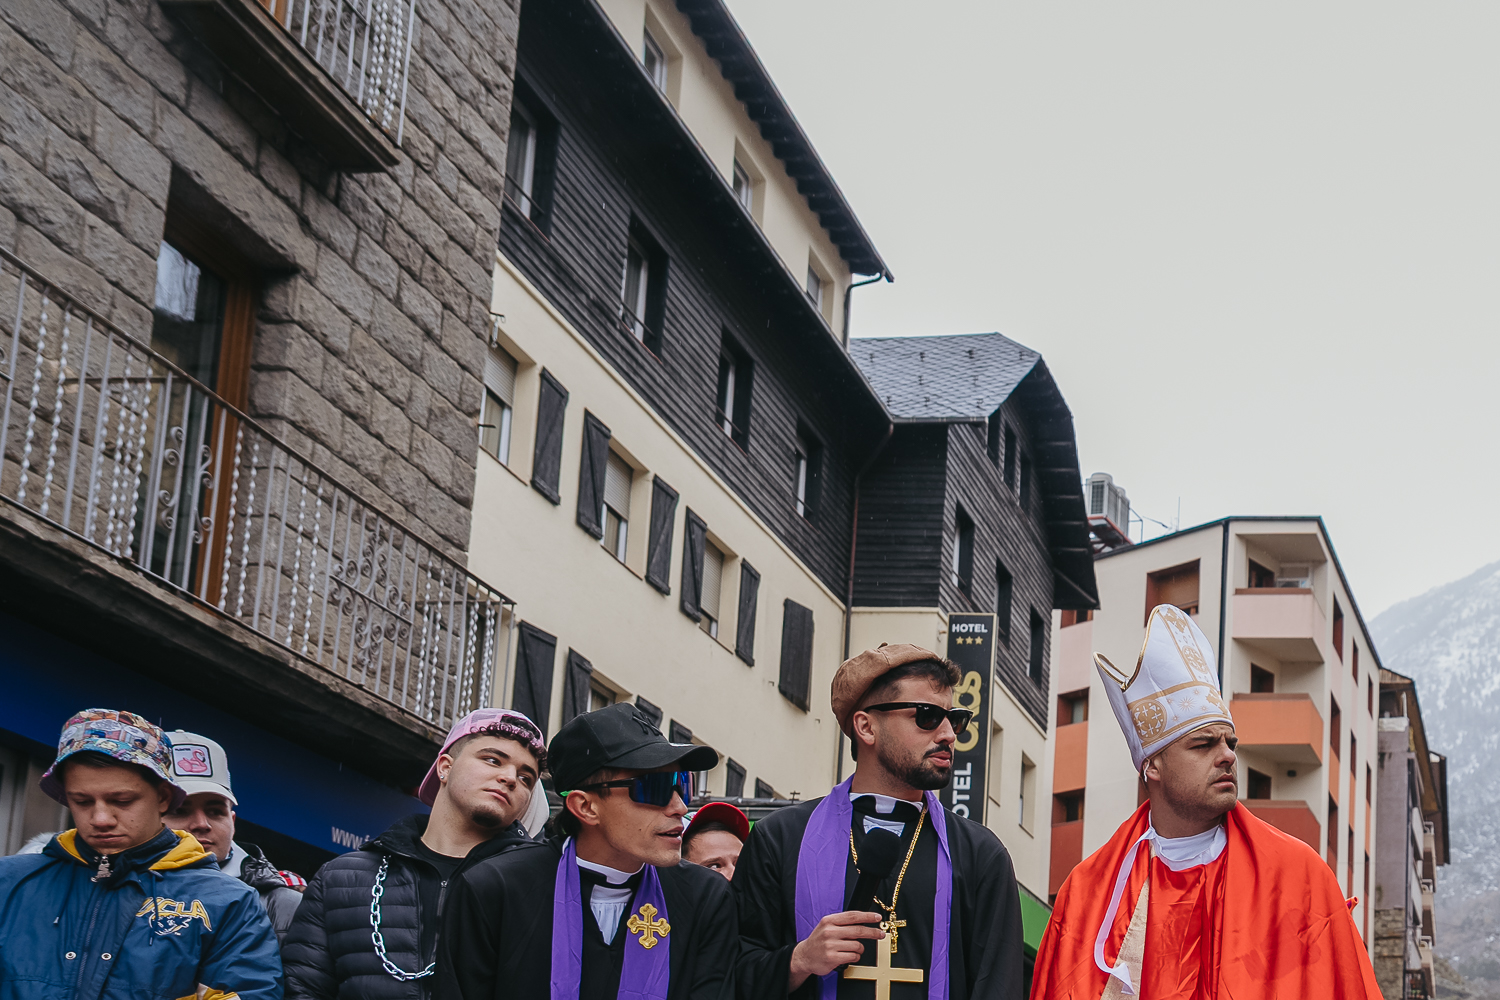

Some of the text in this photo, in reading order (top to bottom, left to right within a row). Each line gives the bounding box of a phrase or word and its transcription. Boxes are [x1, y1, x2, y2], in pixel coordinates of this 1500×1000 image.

[951, 623, 988, 633] HOTEL
[951, 670, 982, 819] OTEL OOS
